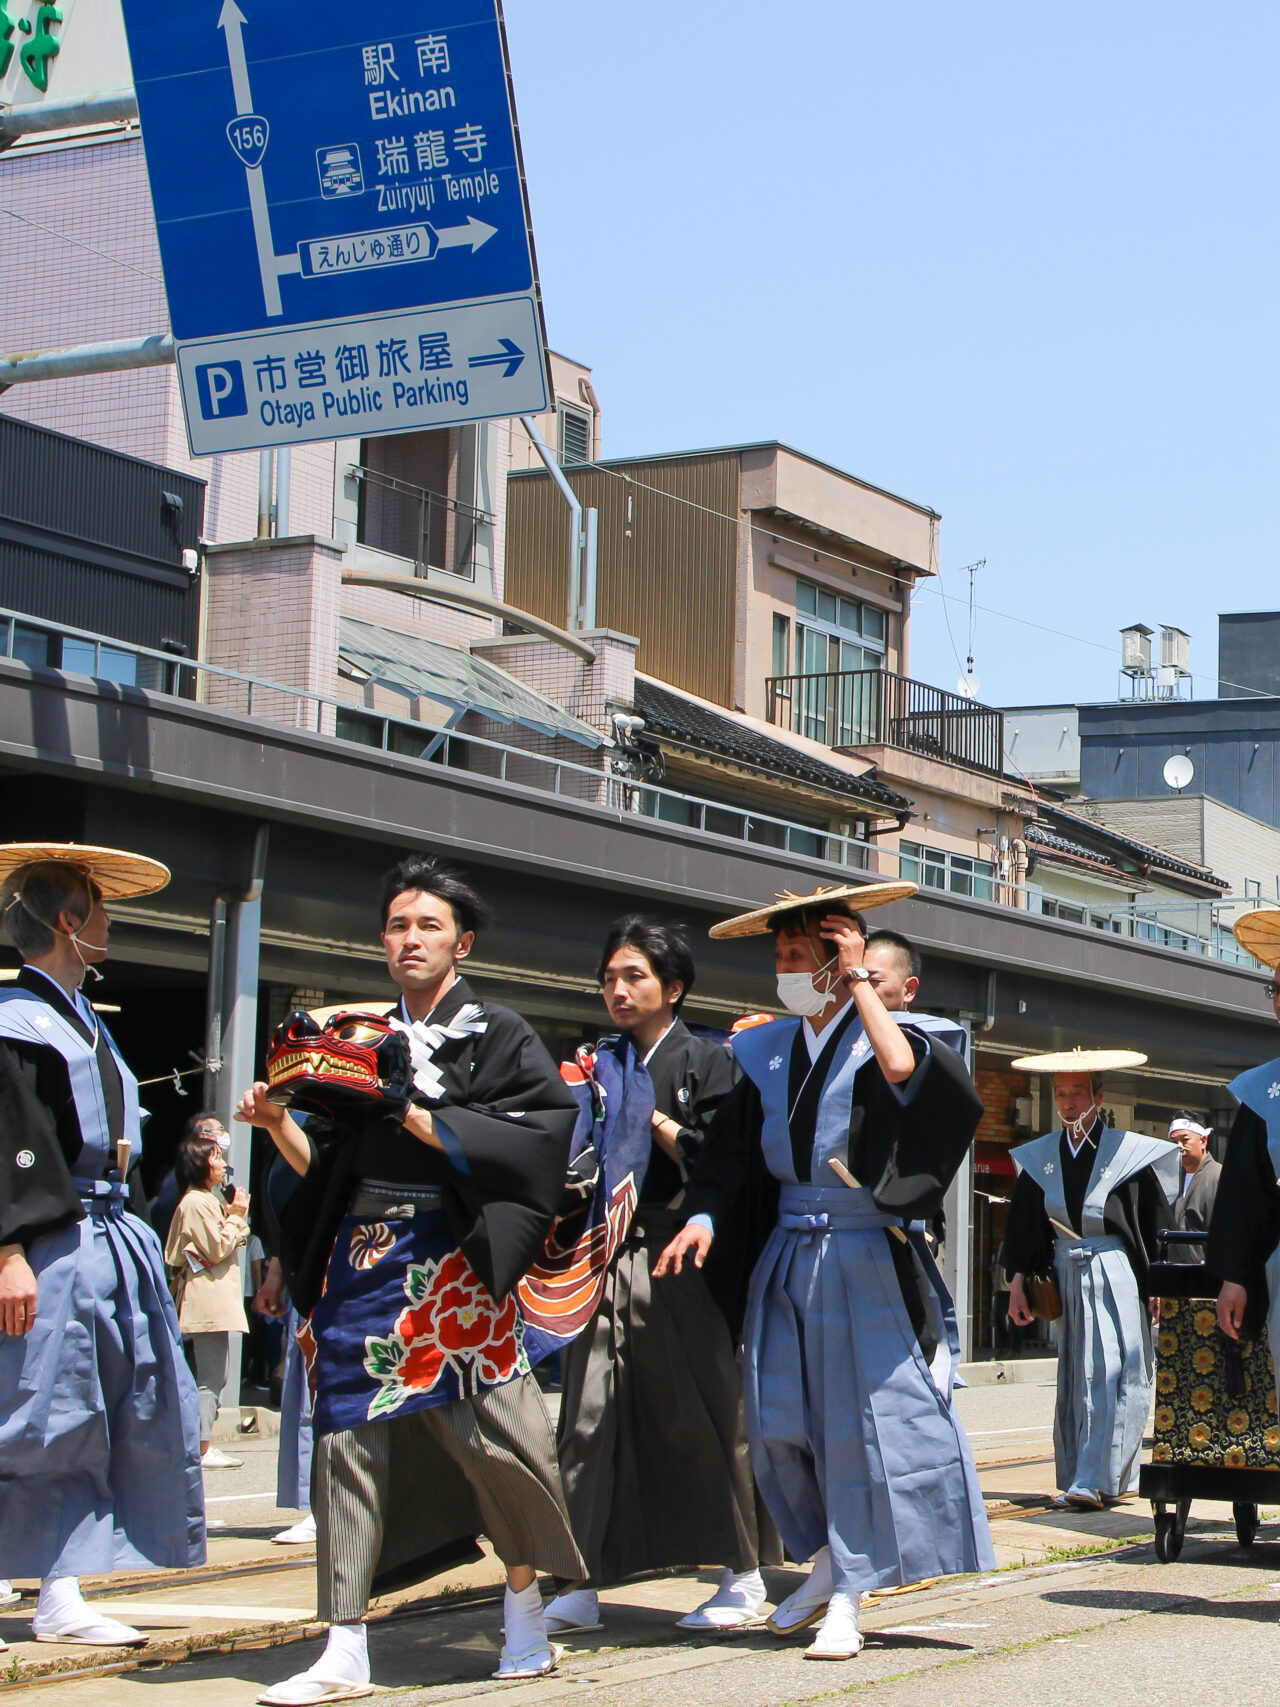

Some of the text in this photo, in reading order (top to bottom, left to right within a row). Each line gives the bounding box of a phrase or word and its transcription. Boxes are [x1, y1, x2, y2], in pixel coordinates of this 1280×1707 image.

[362, 34, 450, 86] 駅南
[368, 86, 456, 120] Ekinan
[233, 125, 264, 150] 156
[375, 122, 487, 176] 瑞龍寺
[375, 168, 499, 213] Zuiryuji Temple
[318, 231, 420, 269] えんじゅ通り
[253, 331, 453, 393] 市営御旅屋
[206, 366, 233, 415] P
[260, 377, 470, 428] Otaya Public Parking
